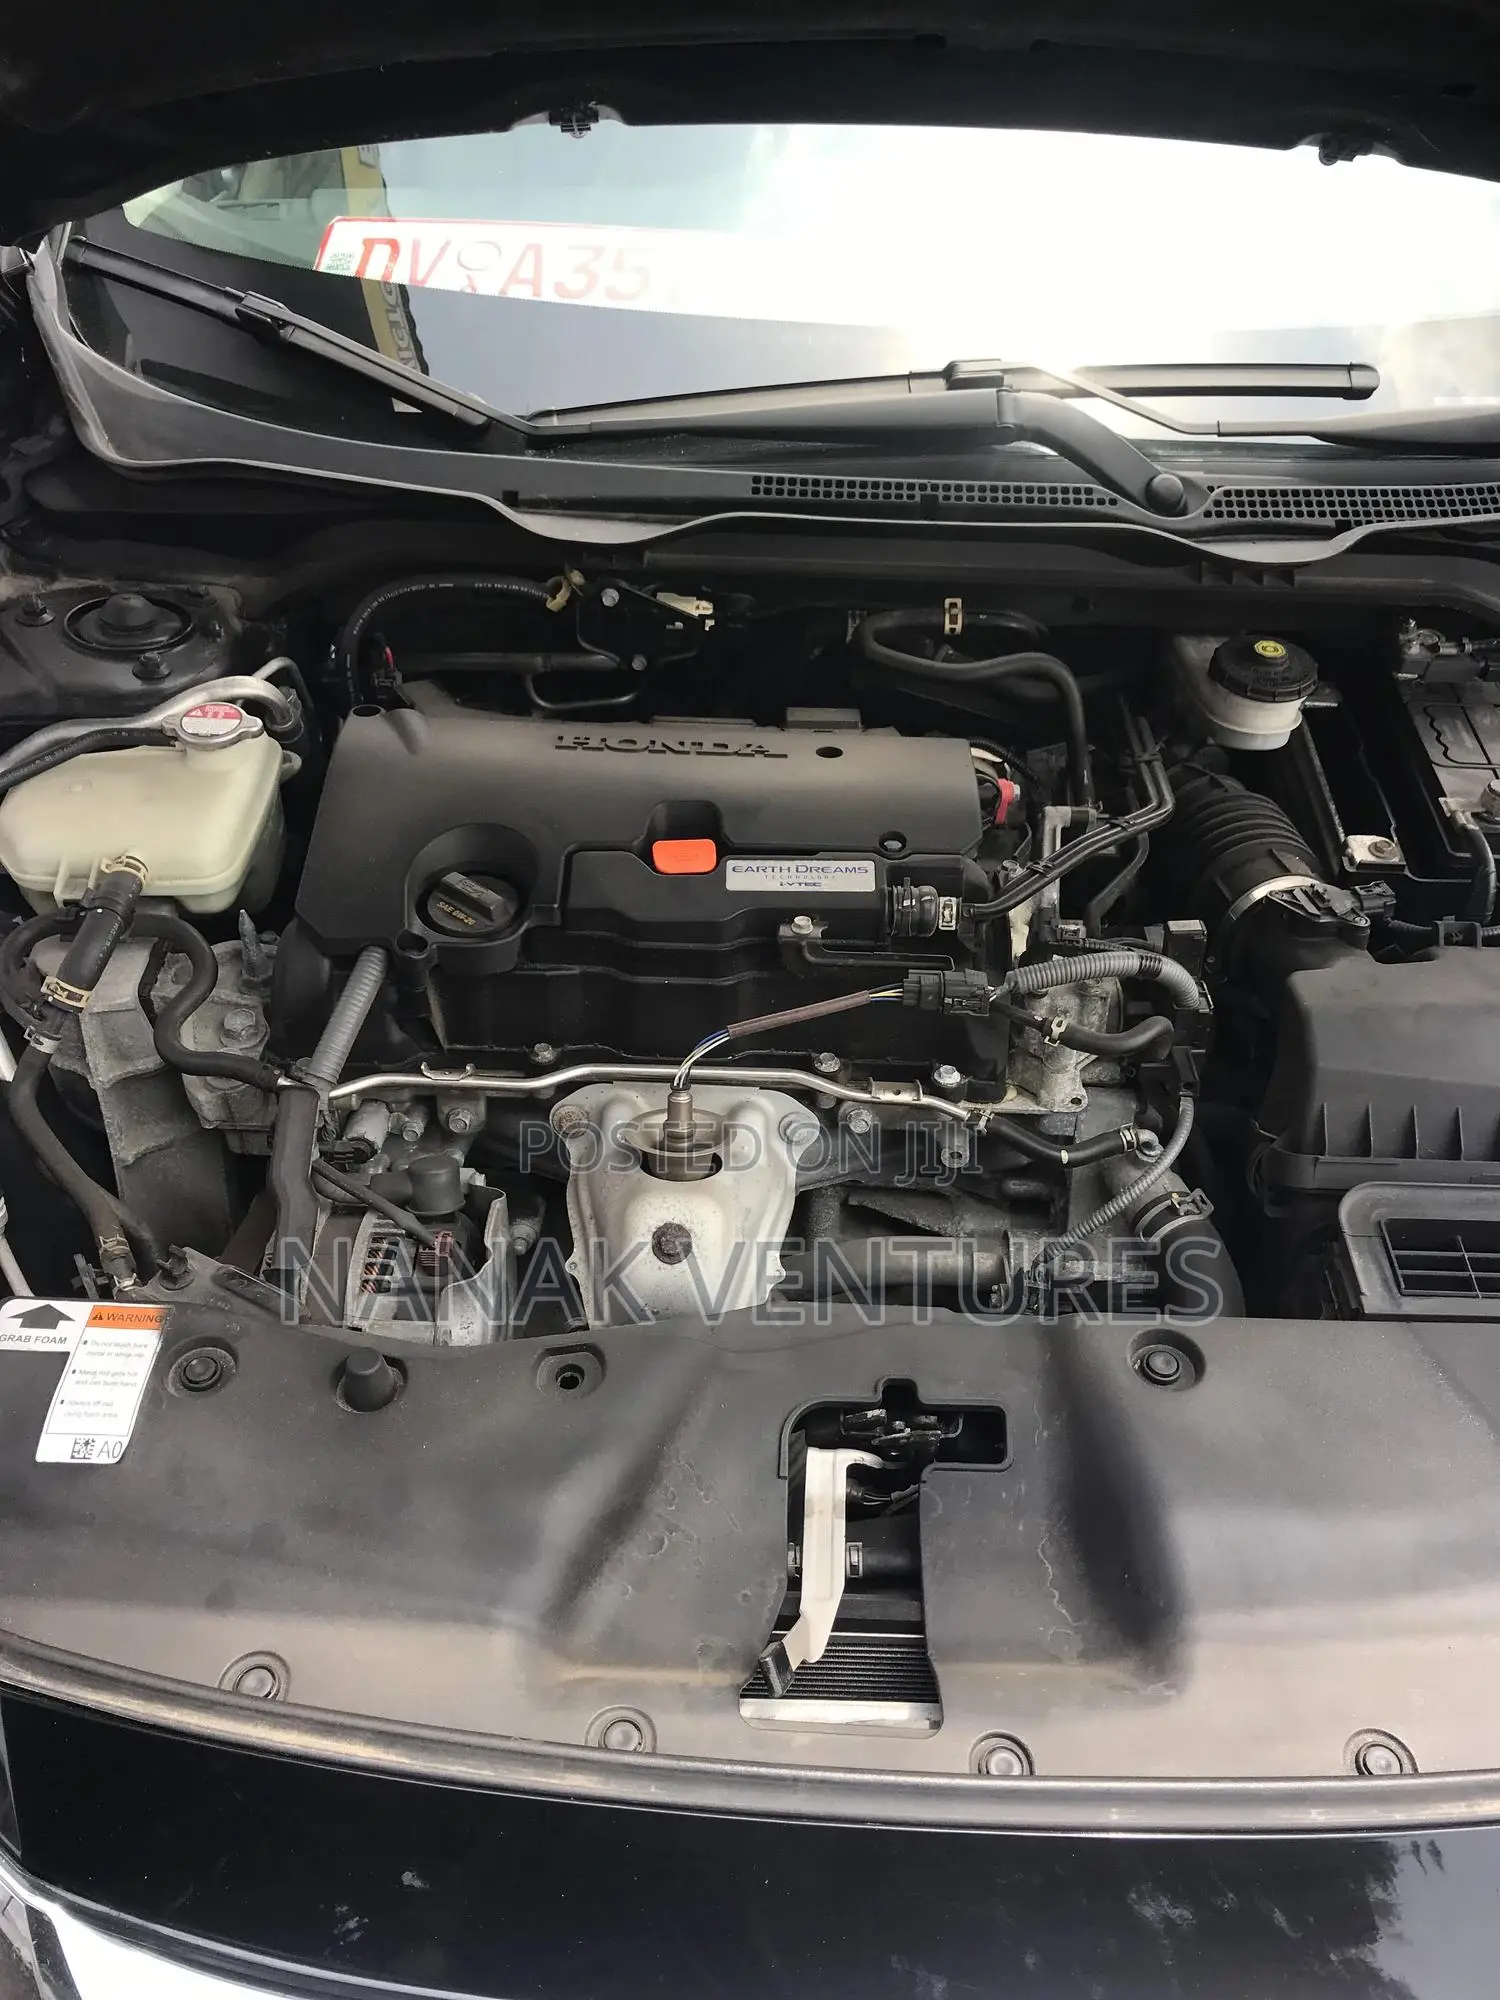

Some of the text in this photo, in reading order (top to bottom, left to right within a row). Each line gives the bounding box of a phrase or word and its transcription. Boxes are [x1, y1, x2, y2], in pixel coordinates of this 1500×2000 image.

[555, 735, 788, 759] HONDA
[731, 864, 869, 874] EARTH DREAMS
[436, 900, 456, 914] SAE
[106, 1312, 164, 1324] WARNING
[0, 1333, 68, 1345] GRAB FOAM
[97, 1440, 123, 1459] A0
